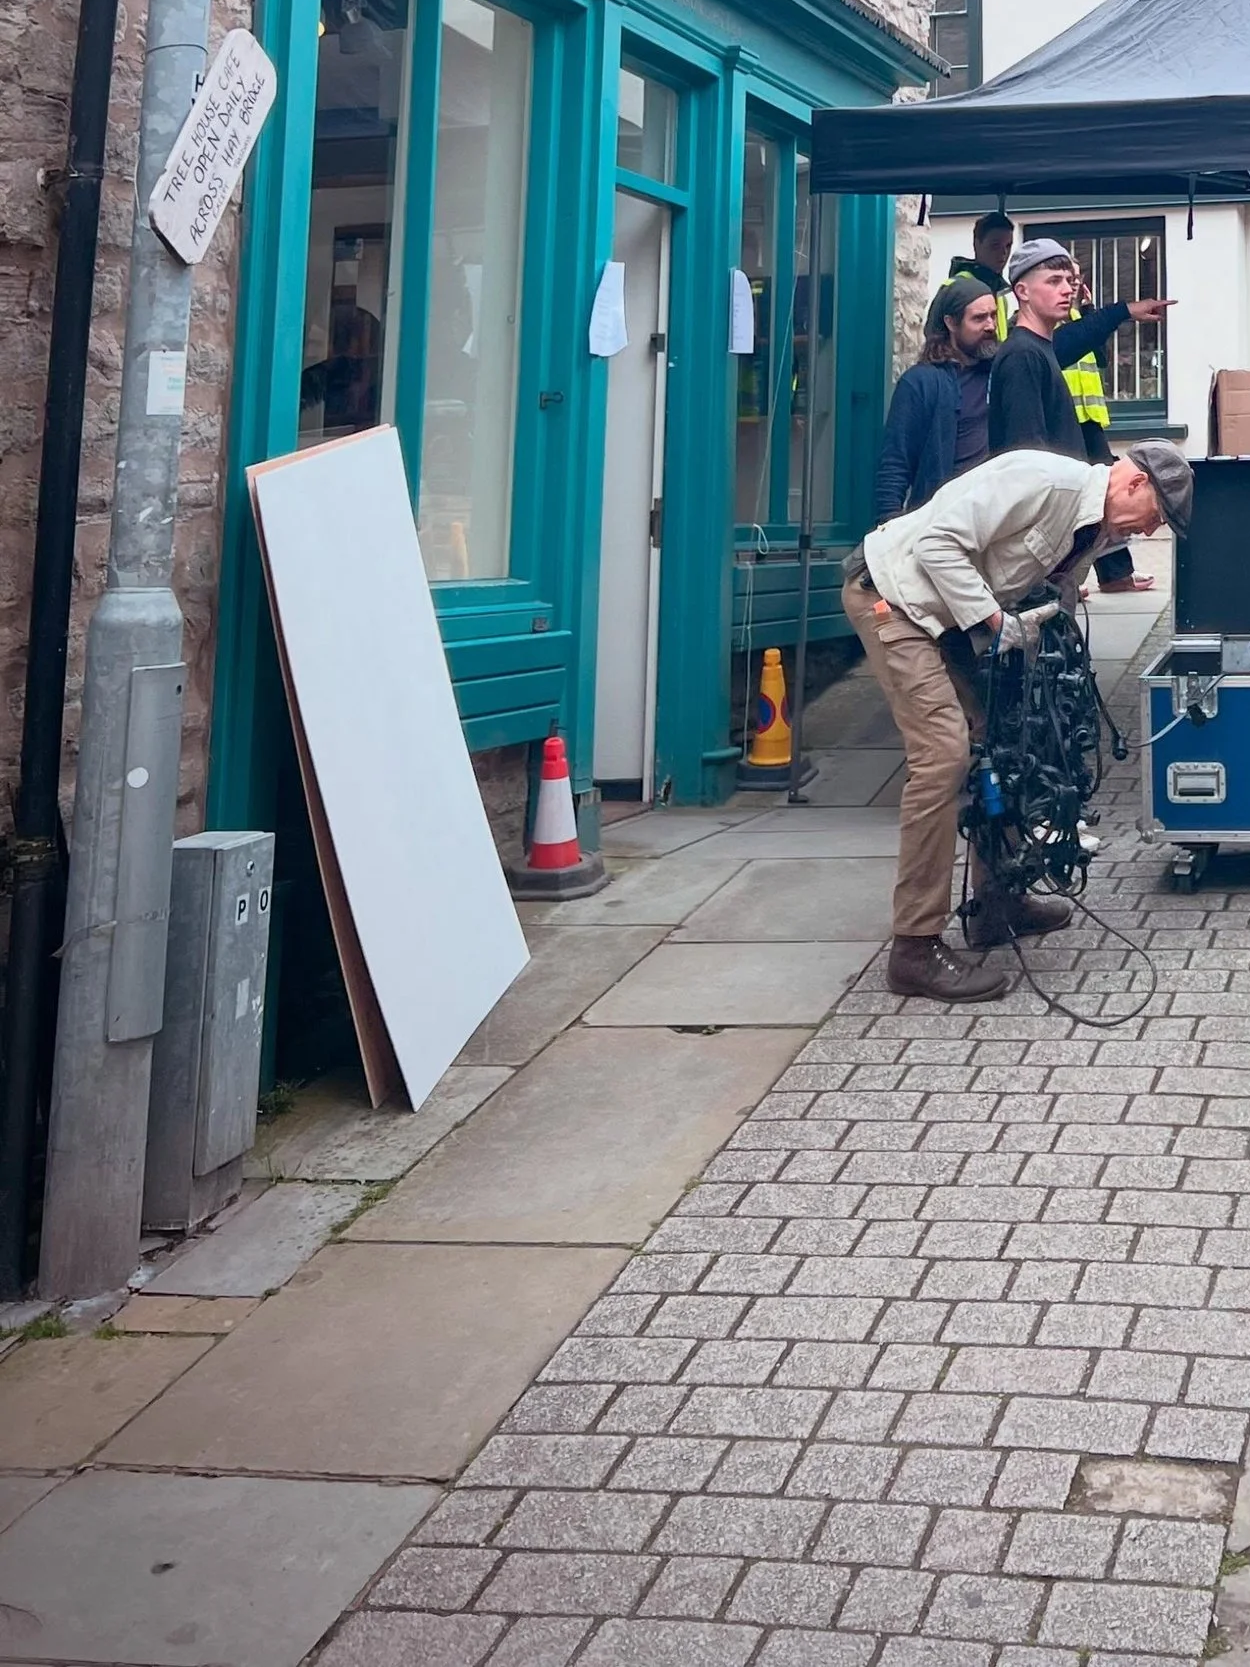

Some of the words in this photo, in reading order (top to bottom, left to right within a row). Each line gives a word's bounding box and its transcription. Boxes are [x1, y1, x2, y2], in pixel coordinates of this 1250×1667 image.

[163, 150, 194, 203] TREE
[191, 95, 220, 148] HOUSE
[218, 48, 241, 91] CAFE
[189, 173, 224, 246] ACROSS
[221, 129, 242, 167] HAY
[239, 72, 265, 126] BRIDGE
[193, 128, 221, 184] OPEN
[218, 76, 247, 128] DAILY
[237, 899, 247, 921] P
